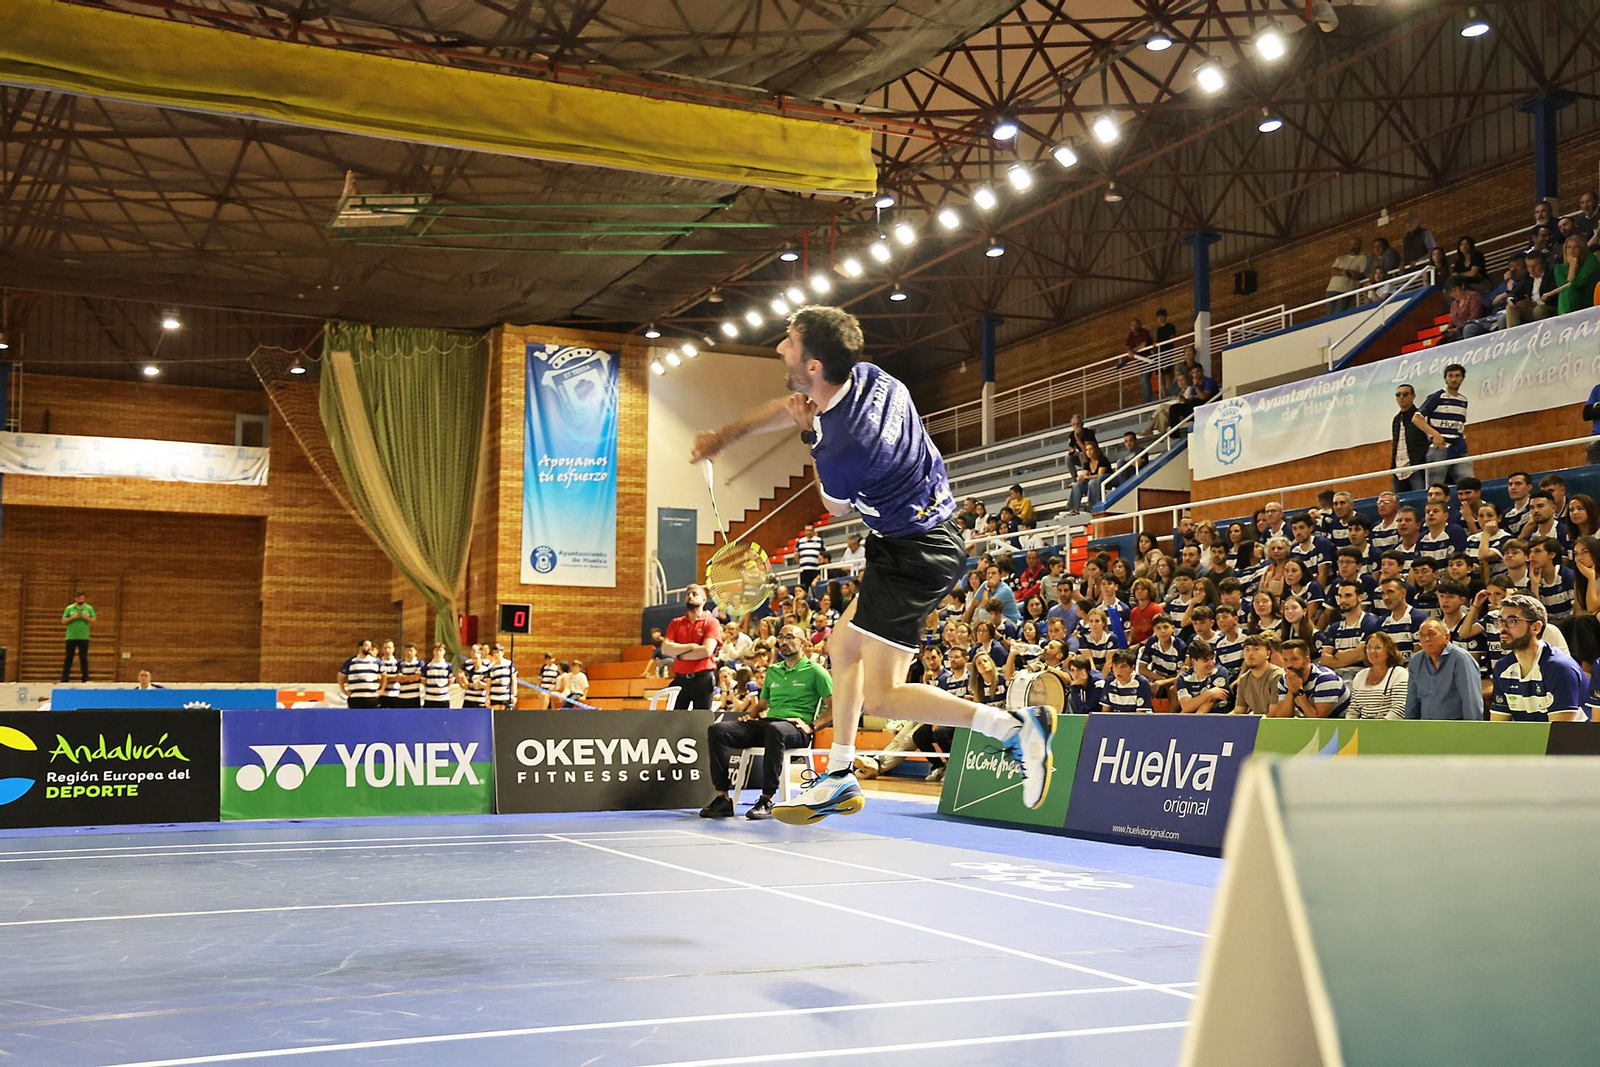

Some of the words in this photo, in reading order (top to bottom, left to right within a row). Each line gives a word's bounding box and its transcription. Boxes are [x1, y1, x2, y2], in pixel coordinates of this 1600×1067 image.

[1392, 359, 1426, 383] La
[1429, 330, 1521, 375] emoción
[1527, 322, 1553, 358] de
[1480, 368, 1504, 398] al
[1511, 351, 1584, 392] miedo
[1255, 374, 1356, 412] Ayuntamiento
[1281, 406, 1298, 421] de
[1303, 393, 1354, 417] Huelva
[538, 454, 608, 475] Apoyamos
[539, 471, 554, 483] tu
[557, 468, 608, 489] esfuerzo
[514, 611, 526, 627] 0
[48, 732, 191, 764] Andalucía
[516, 738, 699, 767] OKEYMAS
[335, 742, 480, 788] YONEX
[976, 752, 998, 772] Corte
[1093, 737, 1218, 791] Huelva
[46, 771, 99, 785] Región
[103, 770, 164, 783] Europea
[167, 769, 190, 780] del
[518, 770, 628, 784] FITNESS
[639, 769, 701, 782] CLUB
[46, 784, 138, 798] DEPORTE
[1163, 795, 1210, 818] original
[1112, 824, 1180, 840] www.huelvaoriginal.com
